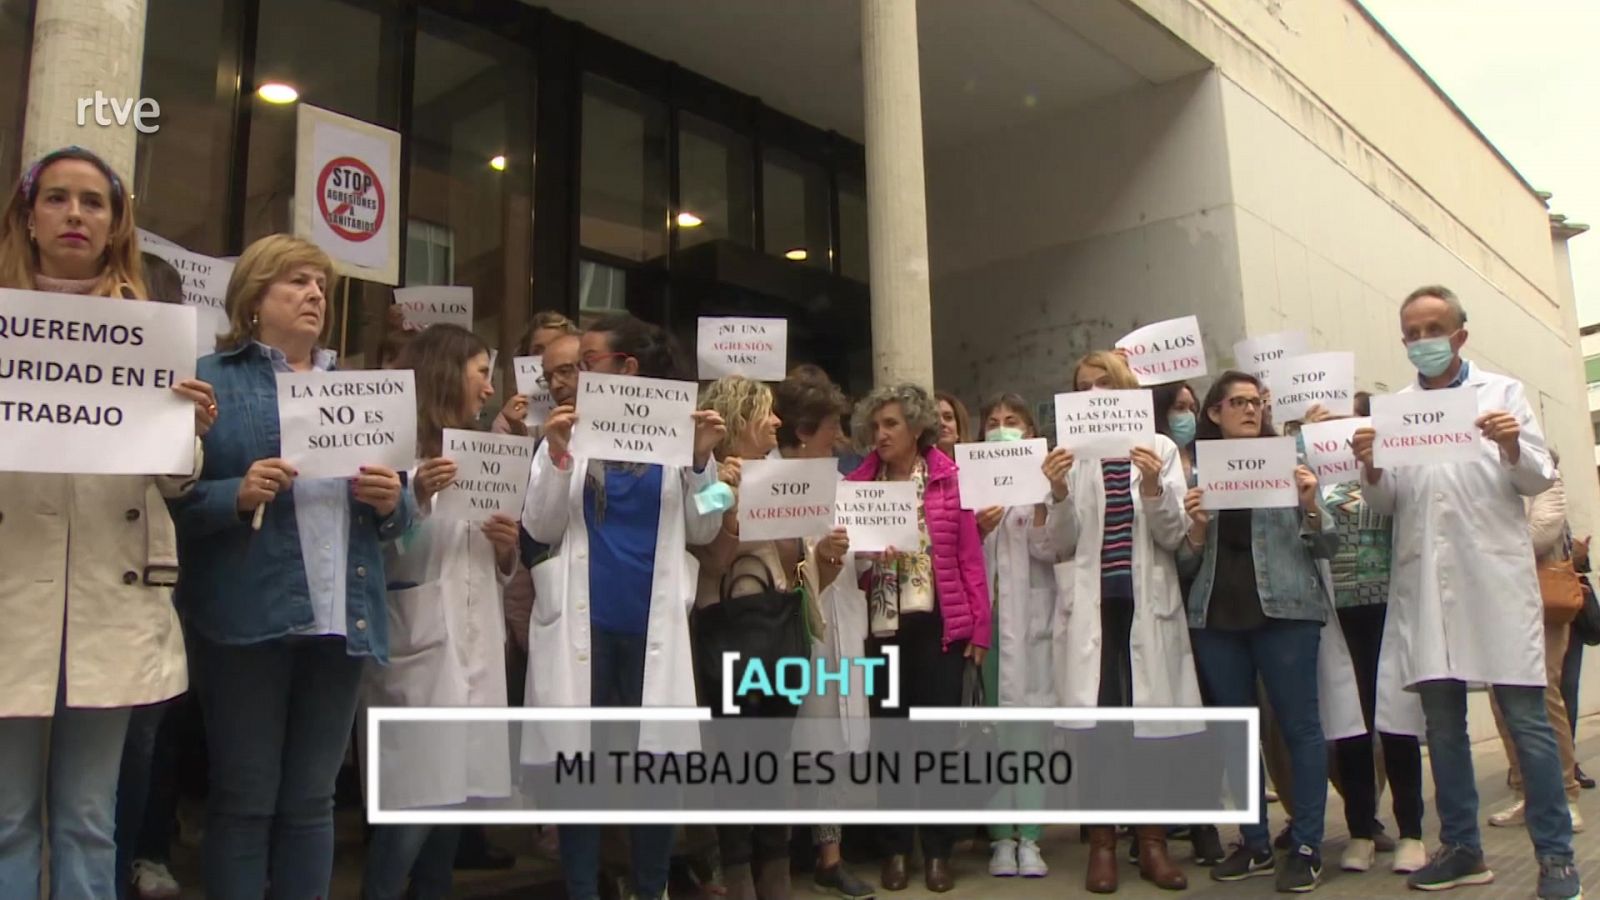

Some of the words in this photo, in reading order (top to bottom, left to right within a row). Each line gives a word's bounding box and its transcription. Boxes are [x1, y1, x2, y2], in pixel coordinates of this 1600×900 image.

[332, 167, 372, 194] STOP
[327, 189, 377, 210] AGRESIONES
[349, 206, 355, 216] A
[328, 212, 375, 232] SANITARIOS
[181, 274, 206, 289] LAS
[404, 302, 424, 312] NO
[428, 303, 436, 313] A
[441, 302, 467, 315] LOS
[719, 324, 735, 336] ¡NI
[742, 324, 766, 334] UNA
[713, 340, 773, 352] AGRESIÓN
[1124, 344, 1146, 356] NO
[1151, 342, 1161, 353] A
[1164, 334, 1196, 351] LOS
[727, 353, 757, 365] MÁS!
[1253, 348, 1285, 364] STOP
[520, 364, 537, 374] LA
[1133, 356, 1200, 376] NSULTOS
[111, 366, 145, 387] EN
[1292, 370, 1327, 386] STOP
[290, 384, 314, 399] LA
[320, 378, 405, 397] AGRESIÓN
[585, 382, 605, 394] LA
[609, 384, 690, 402] VIOLENCIA
[1088, 397, 1120, 407] STOP
[1276, 389, 1349, 407] AGRESIONES
[1, 400, 124, 427] TRABAJO
[319, 405, 355, 426] NO
[364, 410, 384, 424] ES
[624, 402, 650, 418] NO
[1065, 412, 1073, 422] A
[1077, 411, 1100, 421] LAS
[1103, 409, 1149, 420] FALTAS
[1402, 411, 1445, 426] STOP
[591, 420, 677, 438] SOLUCIONA
[1069, 424, 1086, 434] DE
[1088, 422, 1144, 433] RESPETO
[308, 429, 396, 449] SOLUCIÓN
[613, 438, 654, 452] NADA
[1381, 432, 1473, 449] AGRESIONES
[450, 439, 467, 452] LA
[470, 440, 529, 458] VIOLENCIA
[969, 446, 1033, 460] ERASORIK
[1313, 440, 1338, 454] NO
[481, 461, 501, 475] NO
[1227, 459, 1266, 471] STOP
[453, 480, 517, 494] SOLUCIONA
[993, 476, 1014, 486] EZ!
[1207, 479, 1291, 492] AGRESIONES
[771, 483, 811, 496] STOP
[855, 489, 885, 499] STOP
[469, 497, 501, 510] NADA
[844, 502, 865, 512] LAS
[868, 501, 912, 512] FALTAS
[747, 504, 831, 520] AGRESIONES
[837, 515, 852, 526] DE
[855, 515, 907, 526] RESPETO
